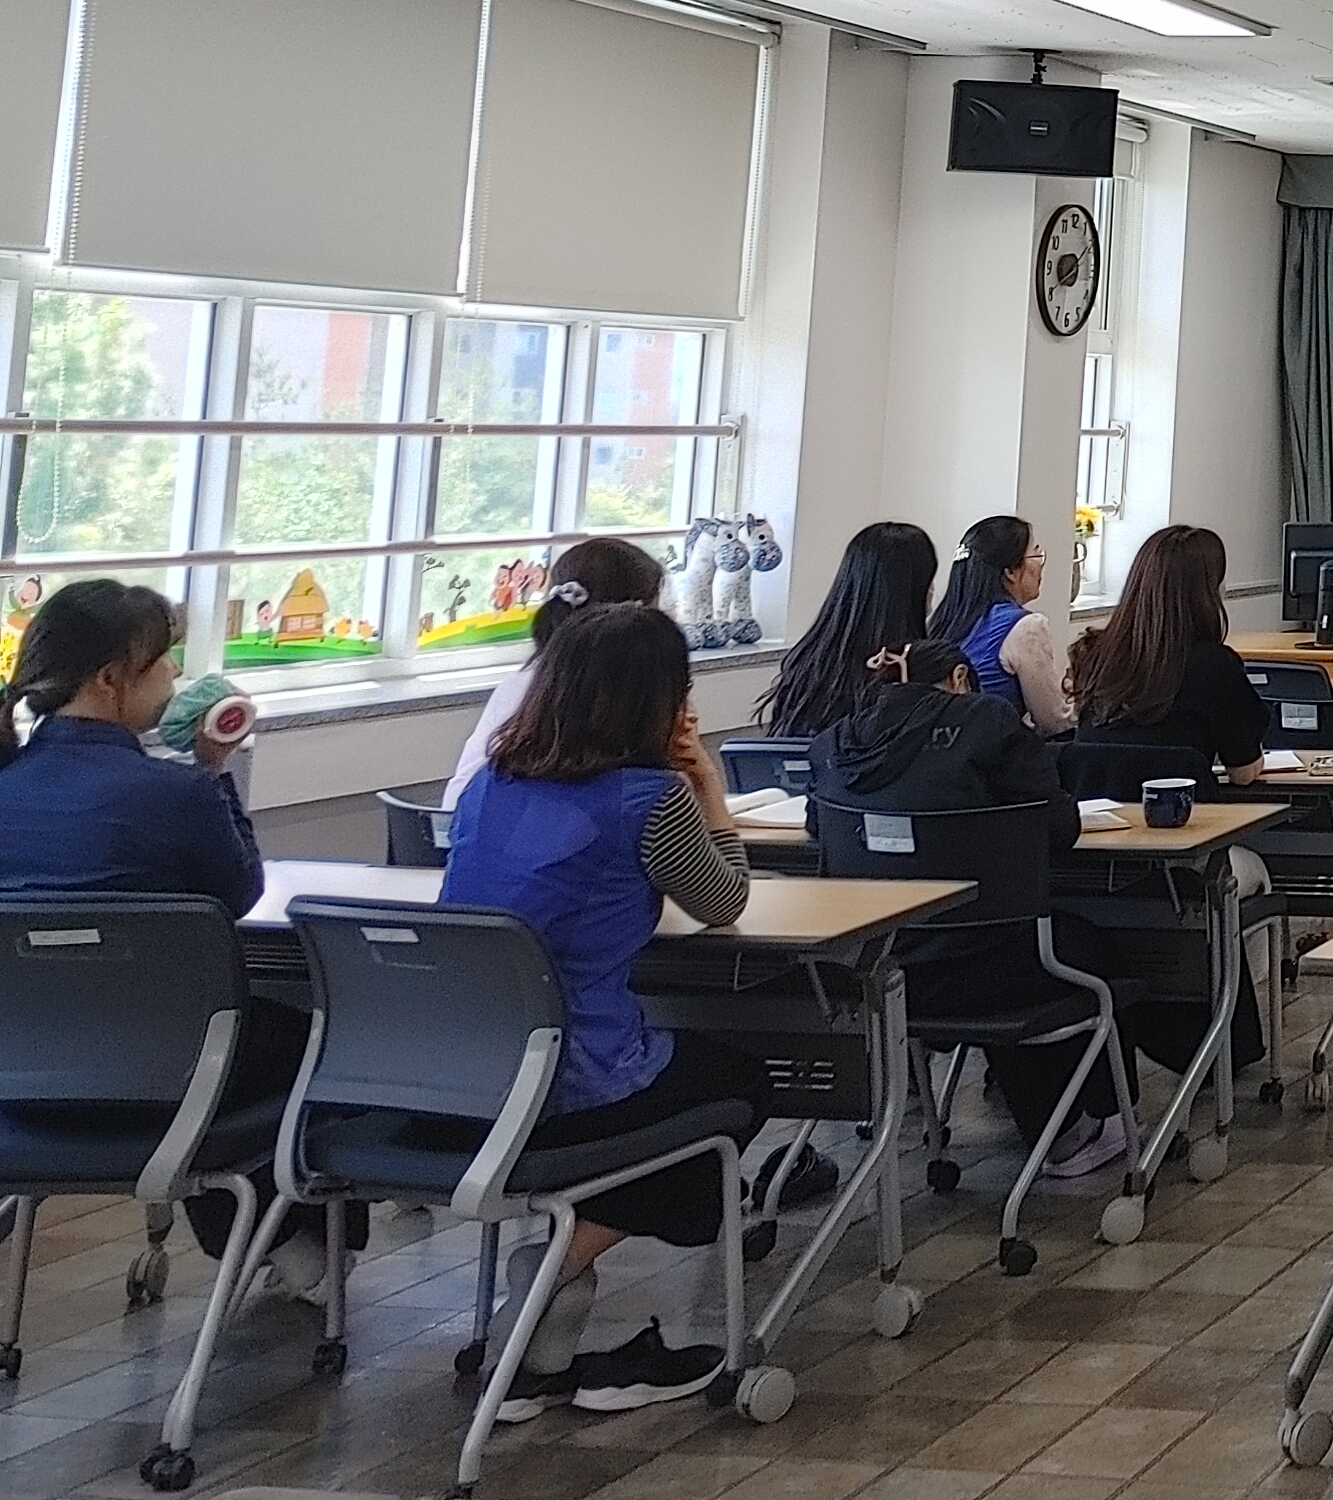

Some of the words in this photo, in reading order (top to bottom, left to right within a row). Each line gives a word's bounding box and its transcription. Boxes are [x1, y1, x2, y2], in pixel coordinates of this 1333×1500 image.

[1061, 218, 1068, 234] 11
[1071, 213, 1080, 229] 12
[1051, 235, 1060, 251] 10
[1046, 260, 1052, 276] 9
[1048, 286, 1054, 302] 8
[1055, 305, 1061, 321] 7
[1064, 312, 1070, 328] 6
[1075, 306, 1081, 322] 5
